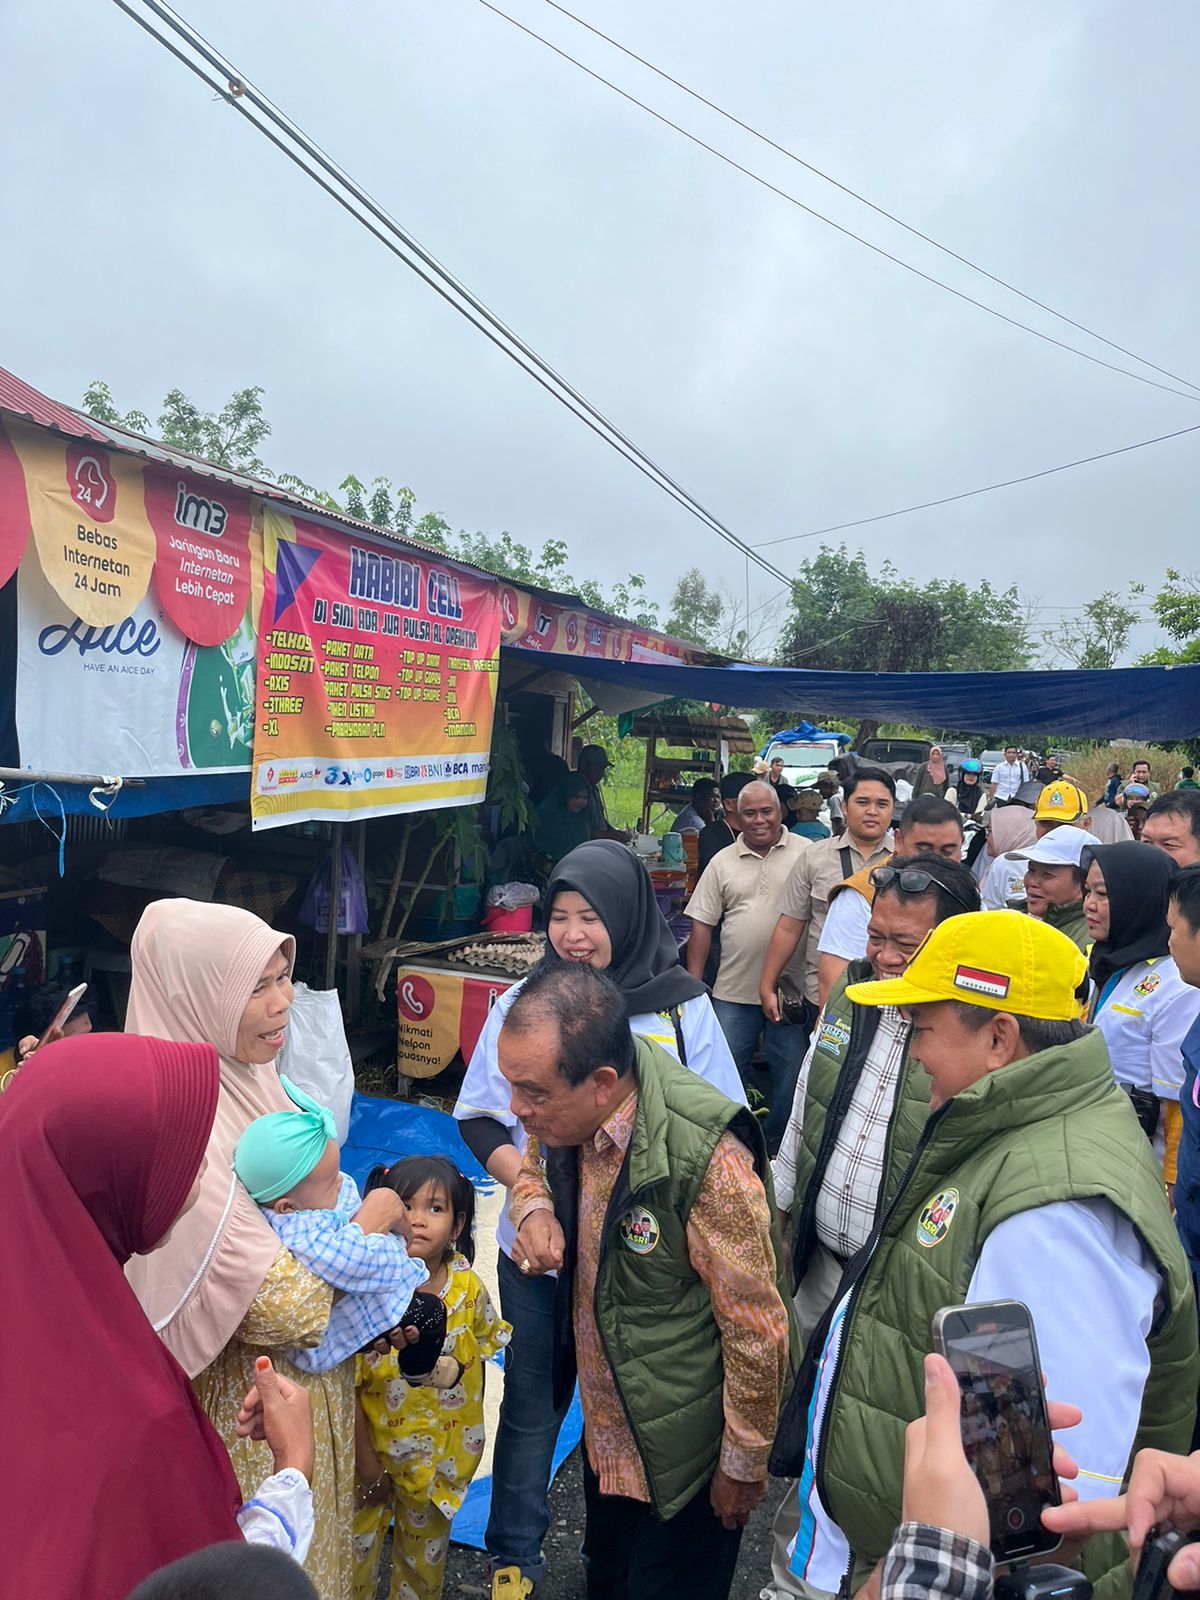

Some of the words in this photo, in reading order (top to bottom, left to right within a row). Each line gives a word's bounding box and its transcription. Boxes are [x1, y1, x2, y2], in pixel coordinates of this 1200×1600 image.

[77, 484, 92, 503] 24
[77, 524, 118, 550] Bebas
[63, 545, 130, 577] Internetan
[169, 536, 215, 561] Jaringan
[215, 549, 240, 568] Baru
[180, 557, 233, 585] Internetan
[74, 572, 88, 591] 24
[90, 577, 121, 597] Jam
[175, 577, 204, 598] Lebih
[205, 585, 234, 606] Cepat
[349, 546, 421, 611] HABIBI
[427, 569, 463, 621] CELL
[313, 598, 328, 624] DI
[331, 601, 354, 629] SINI
[357, 607, 379, 633] ADA
[403, 616, 431, 642] PULSA
[353, 643, 375, 661] DATA
[83, 662, 105, 673] HAVE
[107, 665, 120, 673] AN
[121, 666, 139, 675] AICE
[140, 667, 156, 675] DAY
[351, 663, 380, 681] TELPON
[350, 682, 373, 700] PULSA
[301, 770, 313, 779] AXIS
[428, 764, 442, 777] BNI
[453, 763, 469, 774] BCA
[922, 1218, 939, 1236] ASRI
[627, 1233, 648, 1245] ASRI
